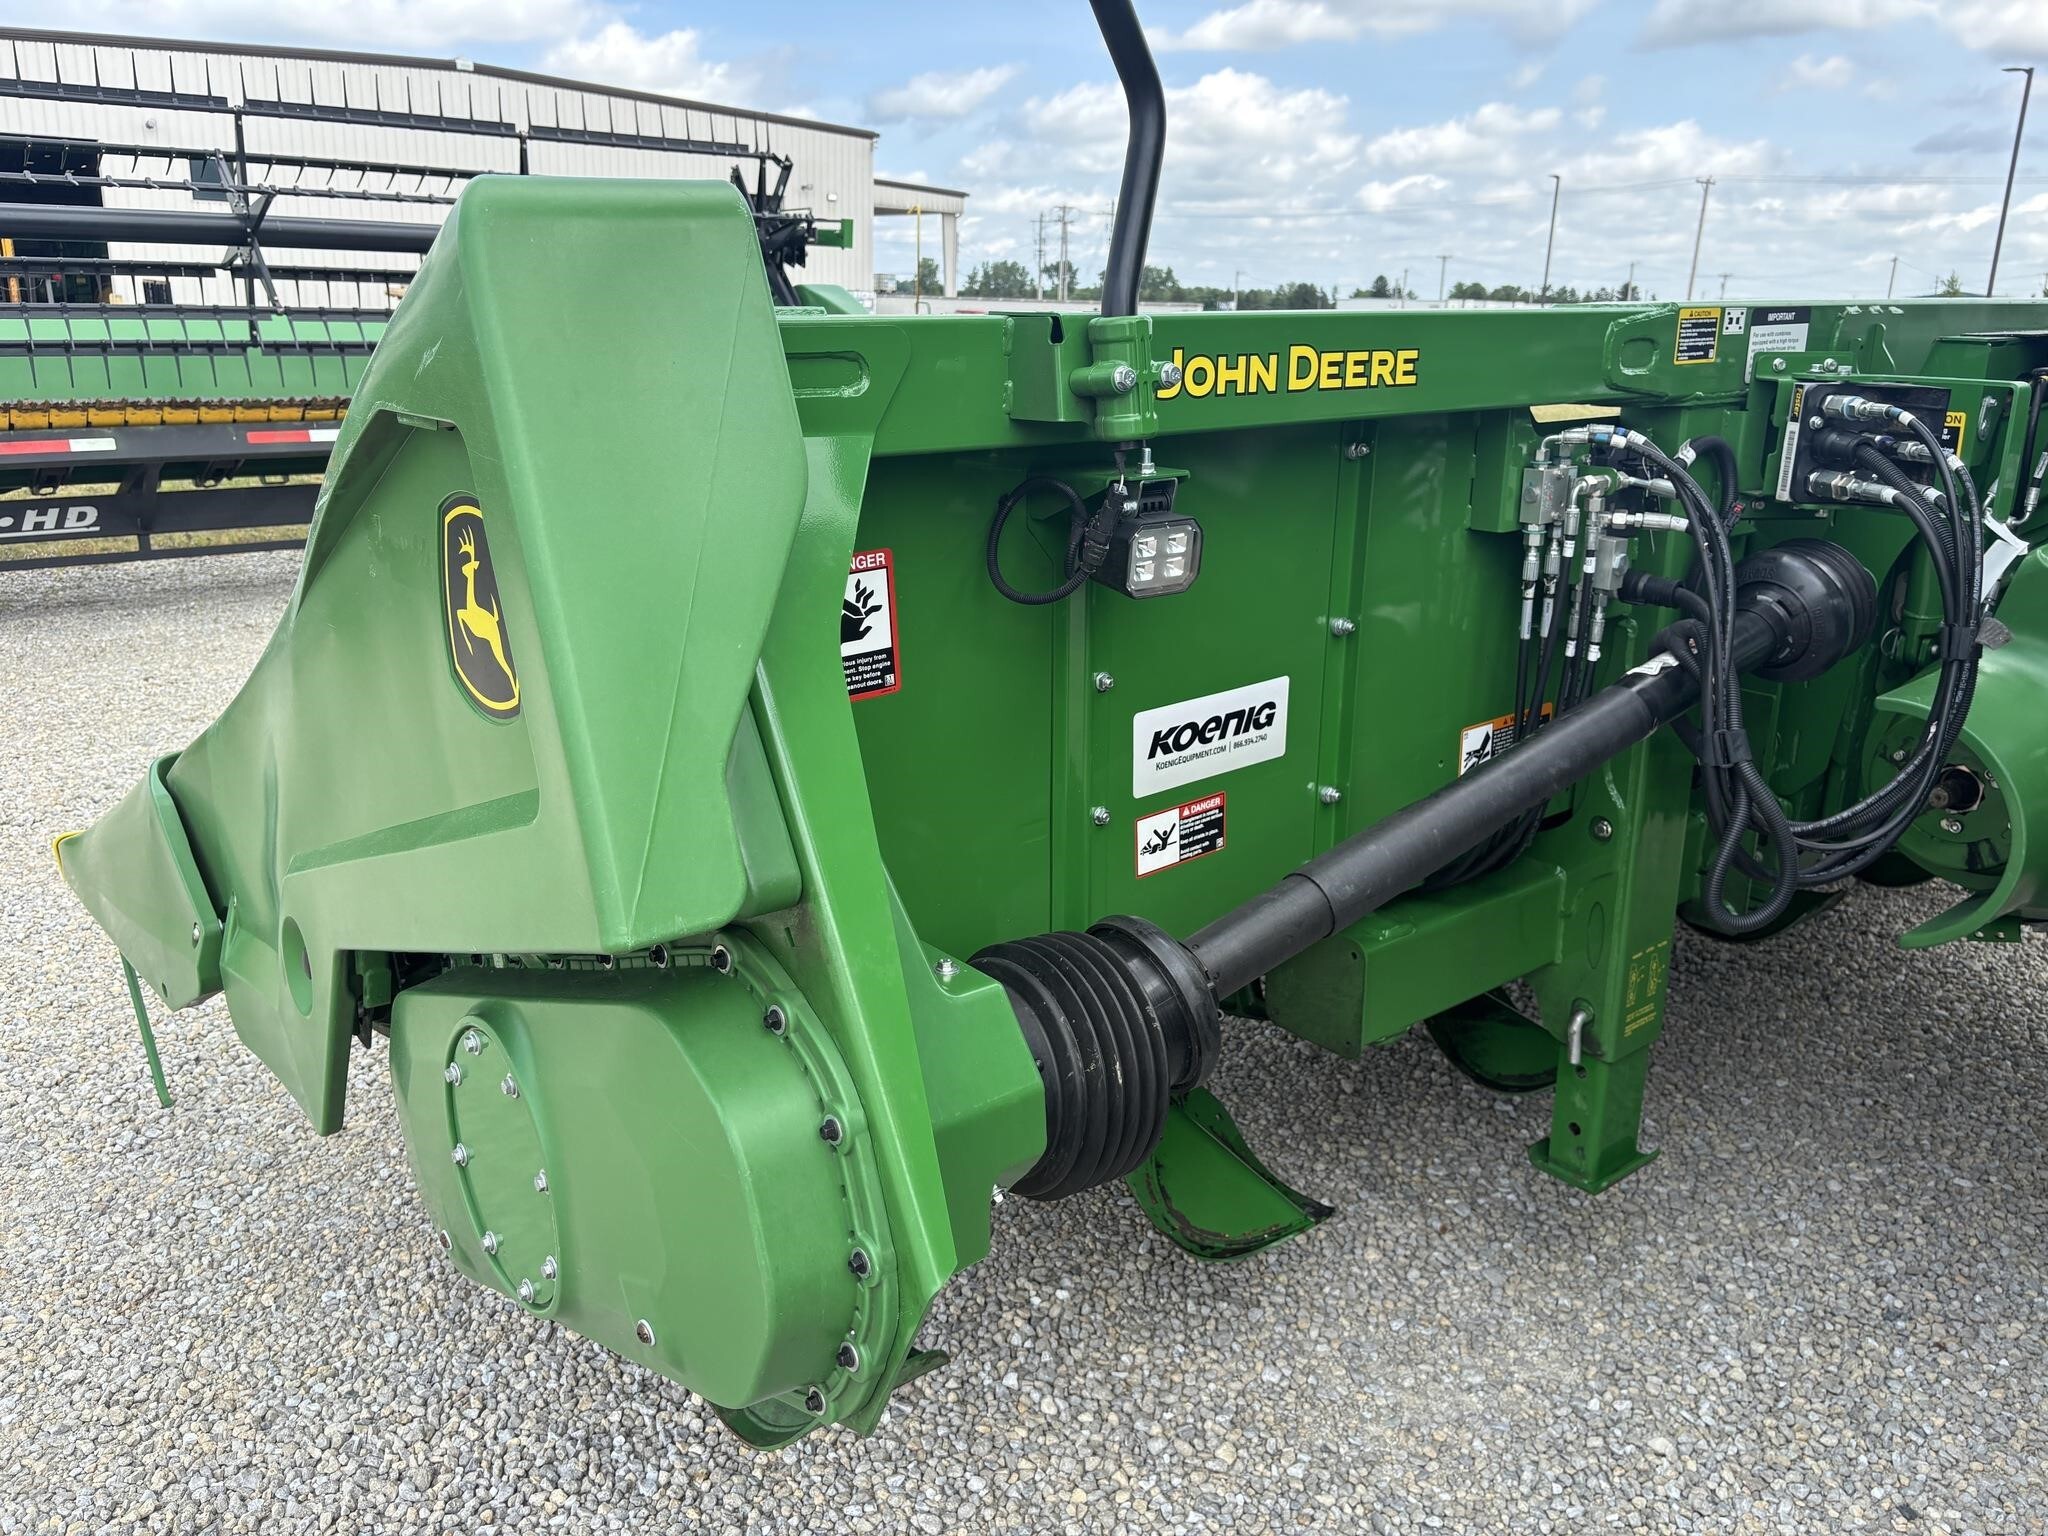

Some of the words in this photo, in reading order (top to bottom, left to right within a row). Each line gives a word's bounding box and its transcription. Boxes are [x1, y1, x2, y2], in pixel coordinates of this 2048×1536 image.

[1767, 311, 1796, 322] IMPORTANT
[1156, 347, 1279, 400] JOHN
[1287, 344, 1420, 391] DEERE
[1793, 387, 1803, 418] Faster
[850, 552, 886, 570] NGER
[857, 656, 873, 665] injury
[874, 653, 887, 661] from
[872, 661, 891, 670] engine
[863, 671, 881, 680] before
[847, 681, 866, 690] eanout
[1233, 733, 1268, 750] 866.934.2740
[1191, 797, 1221, 814] DANGER
